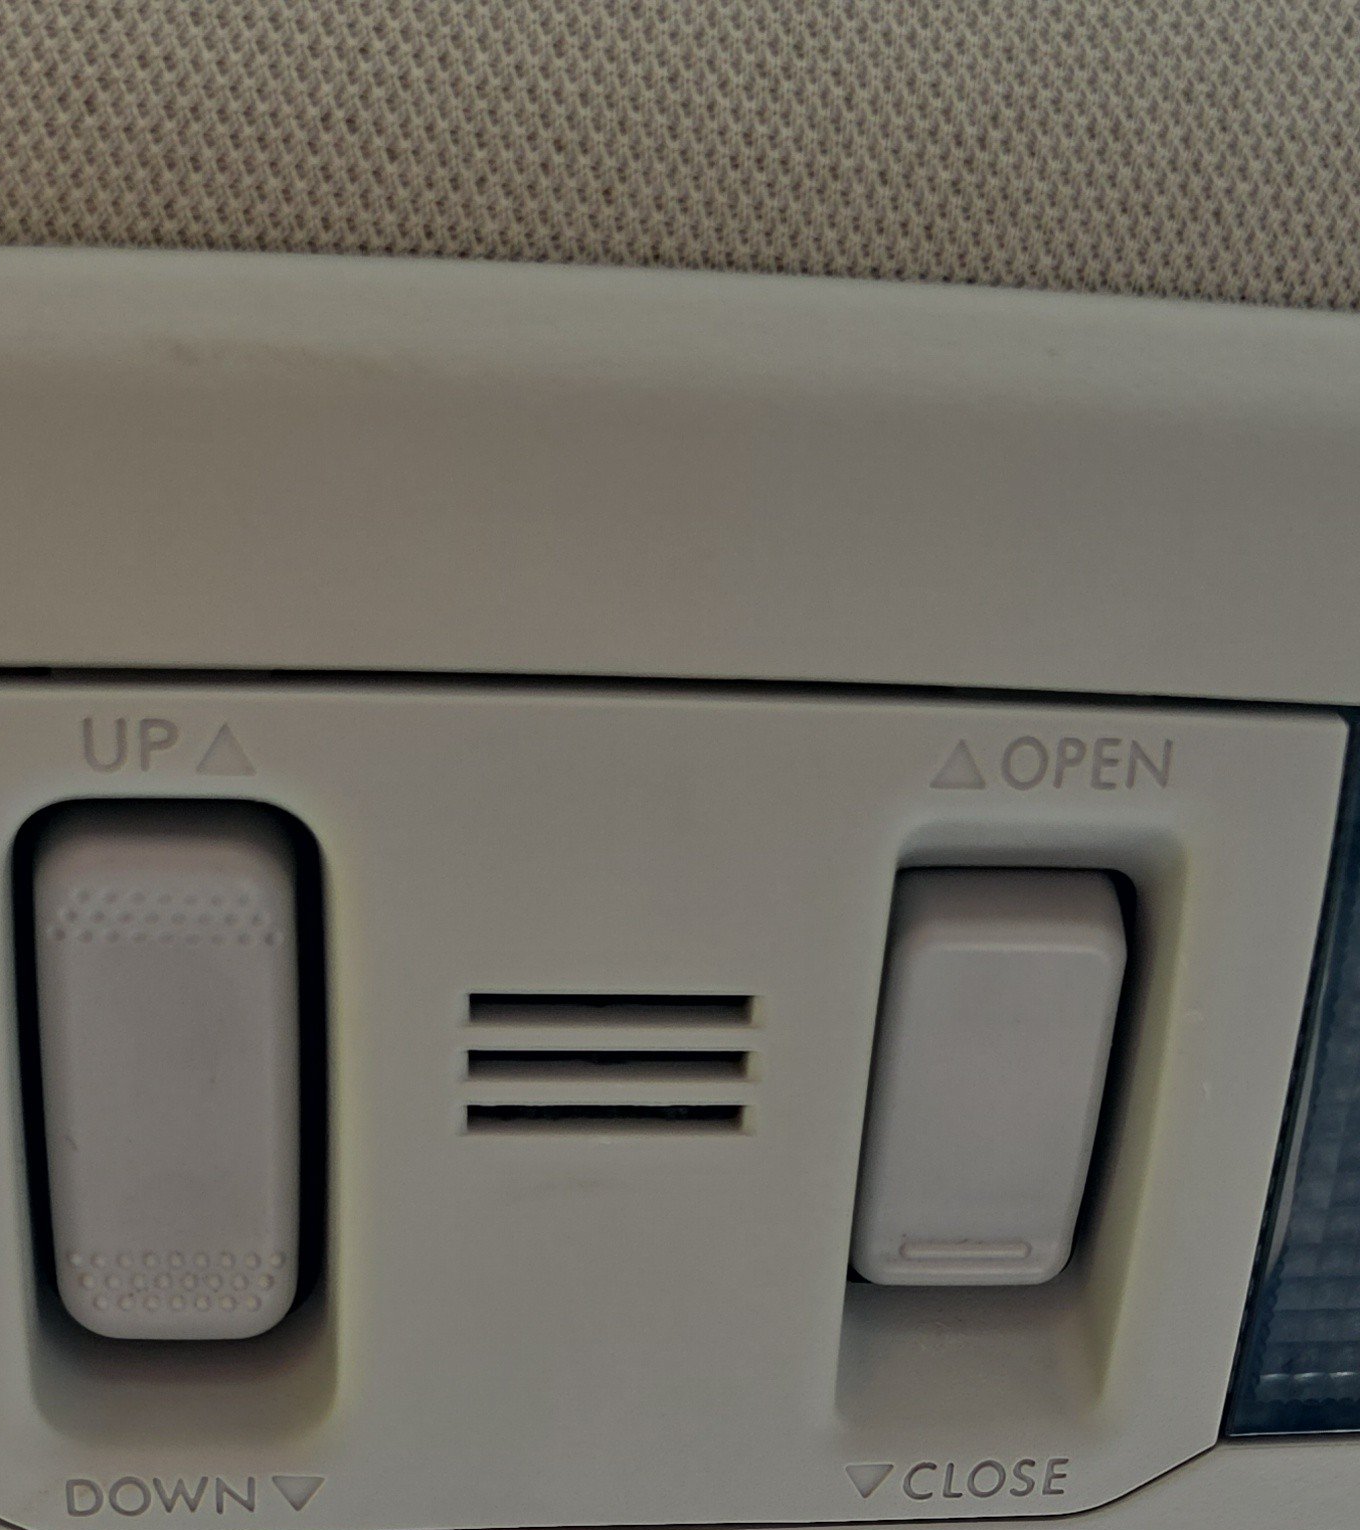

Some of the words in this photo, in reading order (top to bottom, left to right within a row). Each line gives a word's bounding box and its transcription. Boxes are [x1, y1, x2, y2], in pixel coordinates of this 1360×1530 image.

[82, 716, 181, 774] UP
[1000, 735, 1174, 791] OPEN
[65, 1475, 256, 1517] DOWN
[903, 1458, 1070, 1500] CLOSE
